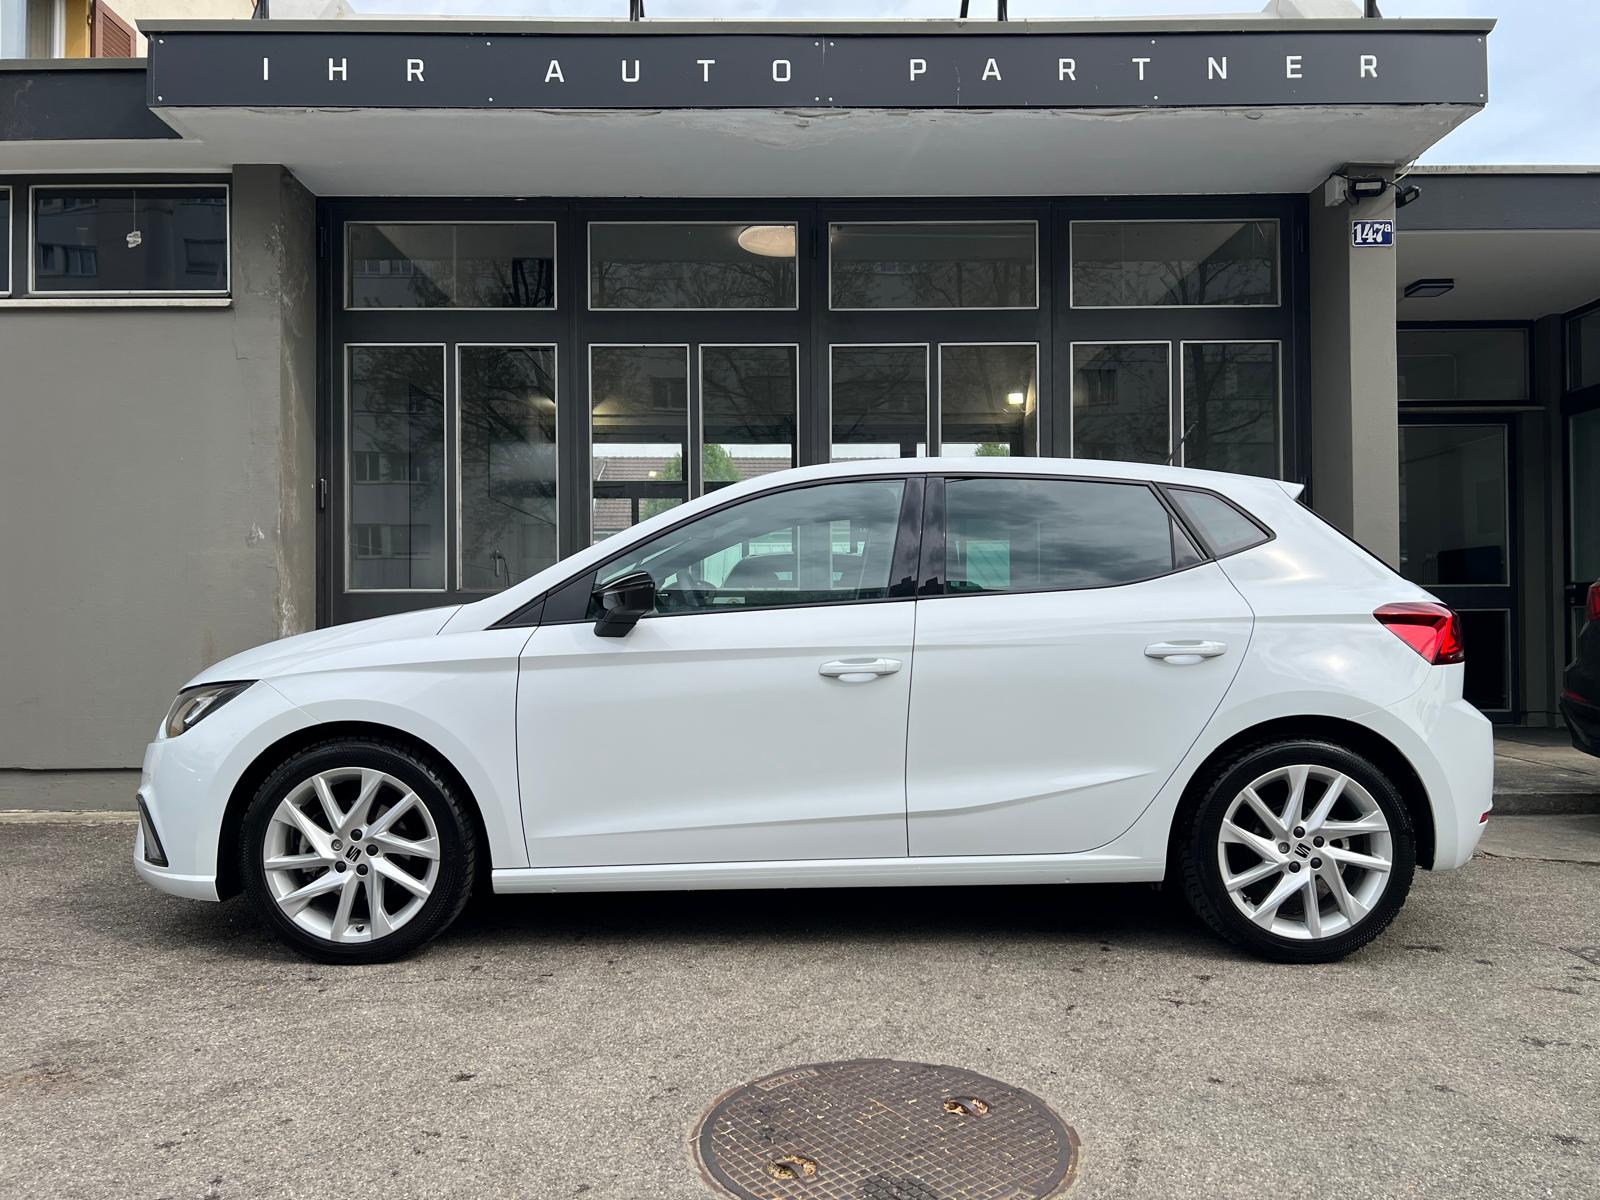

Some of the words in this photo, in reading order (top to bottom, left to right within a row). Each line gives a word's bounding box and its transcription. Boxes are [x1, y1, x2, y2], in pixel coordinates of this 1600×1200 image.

[263, 57, 425, 82] IHR
[544, 59, 791, 83] AUTO
[909, 54, 1378, 82] PARTNER
[1353, 223, 1392, 243] 147a
